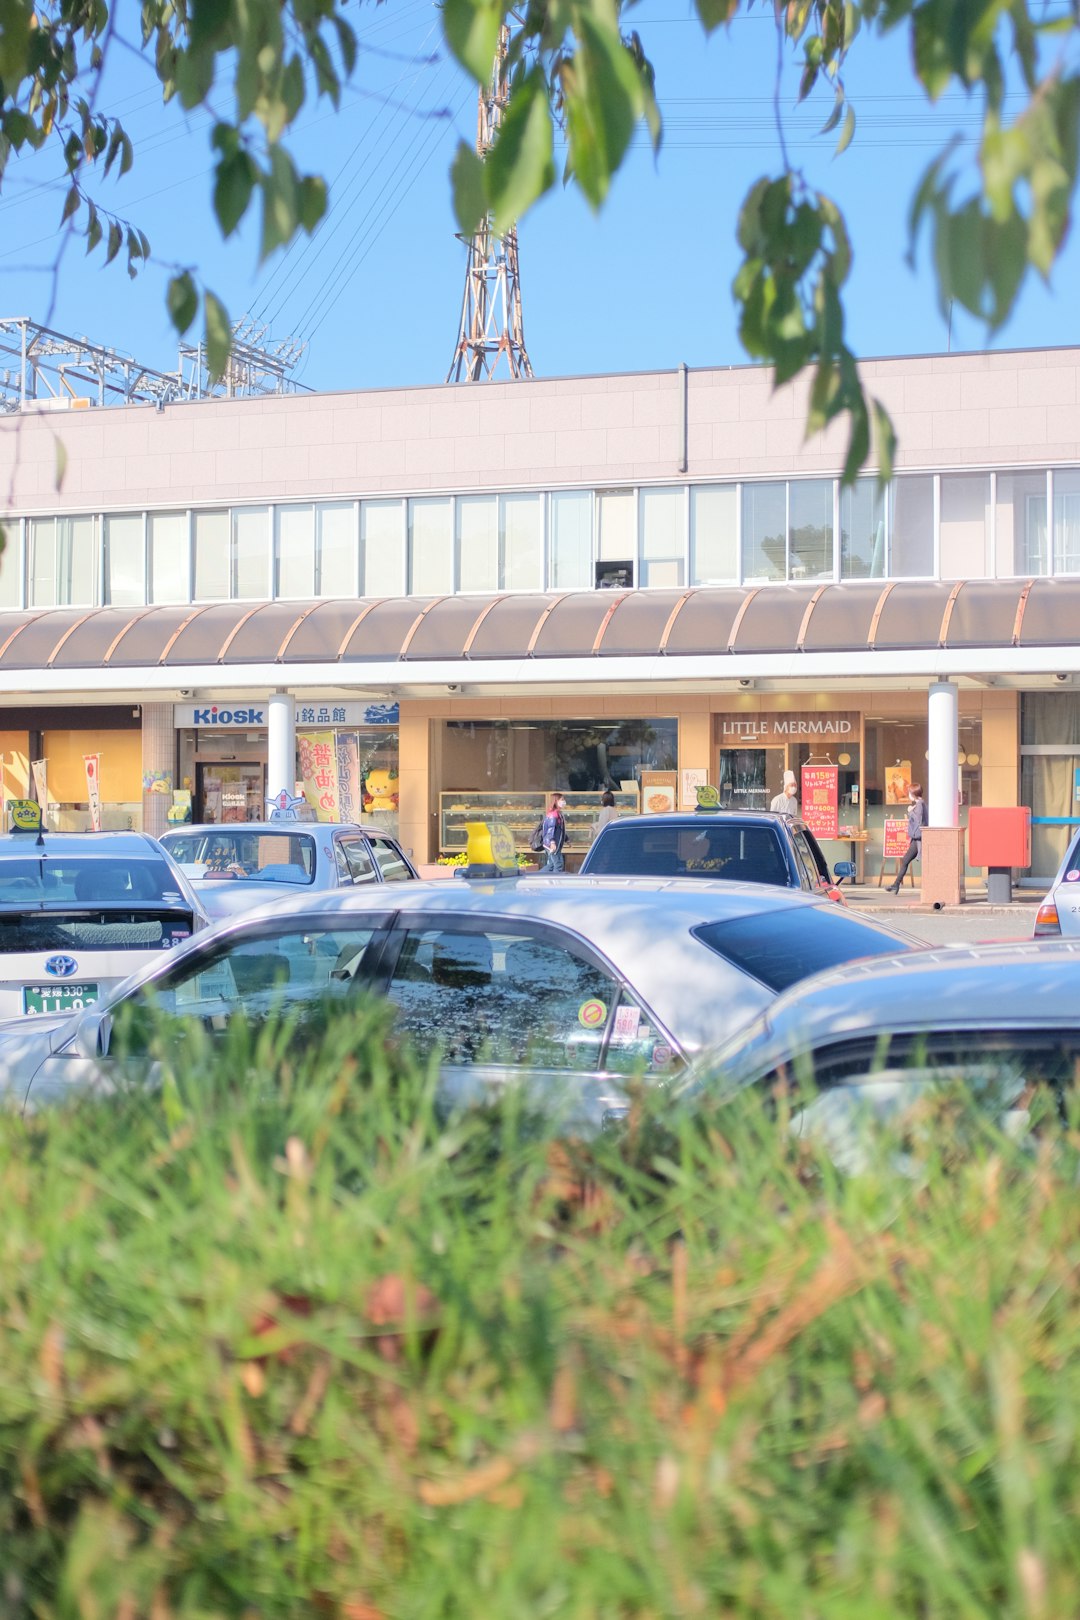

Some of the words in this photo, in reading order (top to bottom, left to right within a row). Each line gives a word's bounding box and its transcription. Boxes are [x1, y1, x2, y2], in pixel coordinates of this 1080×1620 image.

[194, 706, 263, 724] Kiosk
[723, 721, 768, 735] LITTLE
[773, 720, 851, 734] MERMAID
[41, 986, 62, 997] 愛媛
[64, 986, 83, 997] 330
